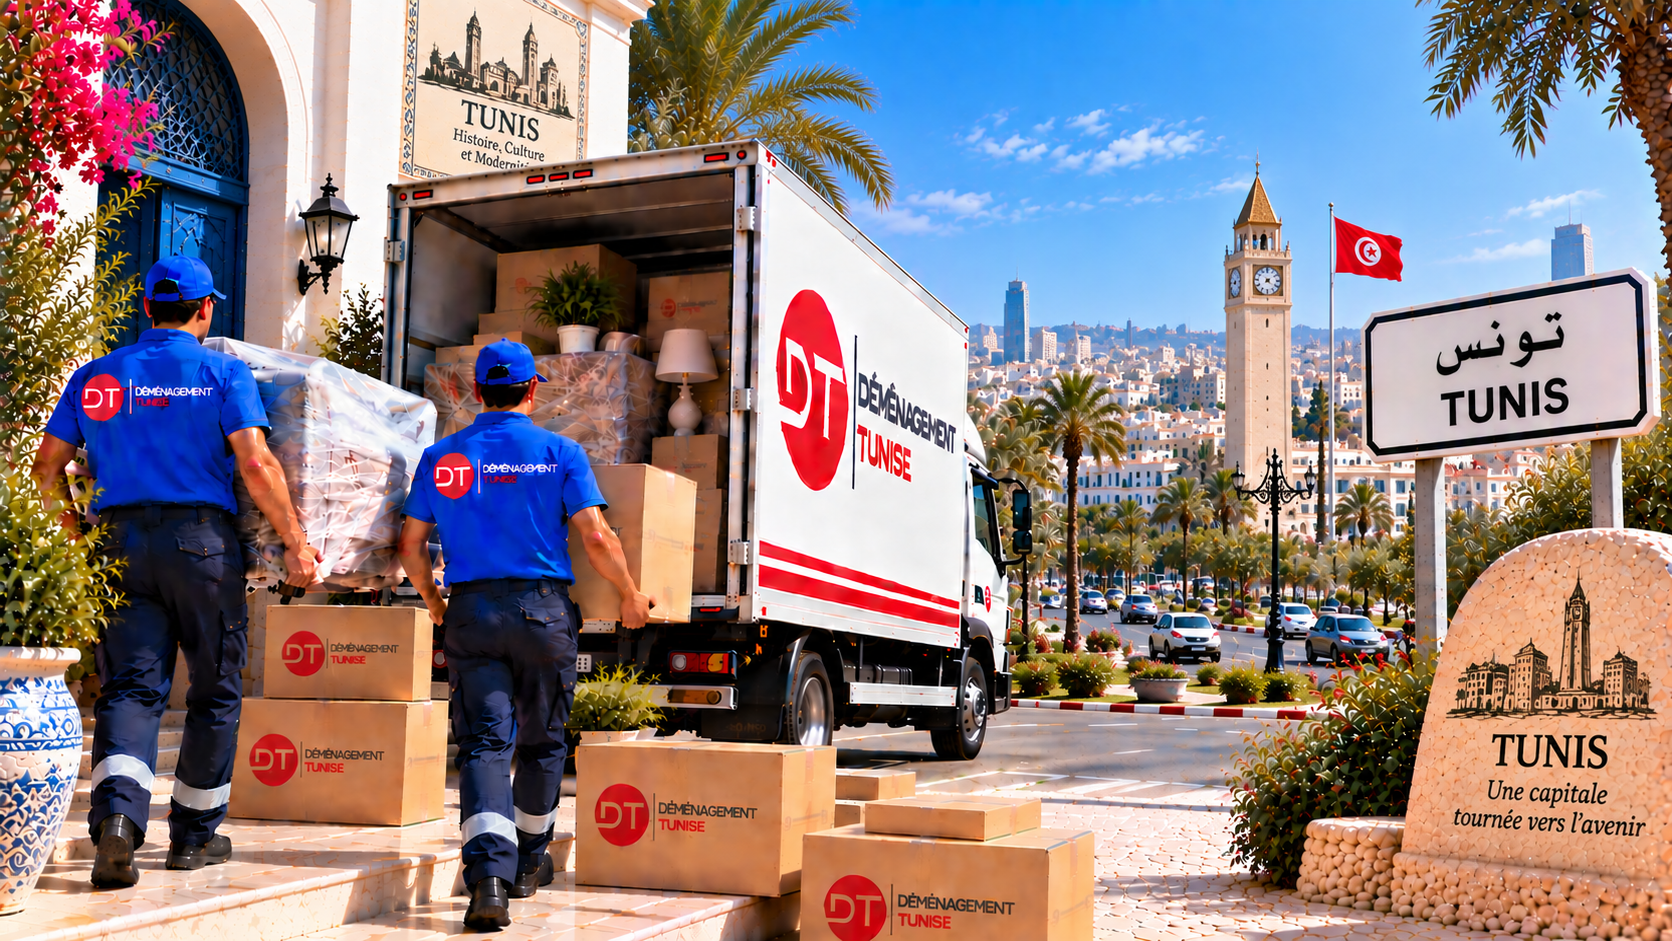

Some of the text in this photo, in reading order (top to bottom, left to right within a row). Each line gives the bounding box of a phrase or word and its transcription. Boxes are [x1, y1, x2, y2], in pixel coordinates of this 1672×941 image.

[461, 99, 540, 142] TUNIS
[453, 128, 545, 162] Histoire, Culture
[460, 149, 530, 170] et Moderni
[1436, 311, 1565, 376] تونس
[83, 388, 120, 409] DT
[779, 337, 847, 441] DT
[1440, 377, 1570, 427] TUNIS
[857, 371, 957, 454] DÉMÉNAGEMENT
[857, 424, 912, 483] TUNISE
[435, 466, 471, 487] DT
[282, 643, 322, 664] DT
[330, 655, 366, 665] TUNISE
[251, 748, 294, 771] DT
[304, 747, 385, 761] DÉMÉNAGEMENT
[1491, 733, 1608, 770] TUNIS
[304, 762, 344, 773] TUNISE
[1487, 779, 1608, 809] Une capitale
[595, 801, 644, 830] DT
[658, 800, 758, 820] DÉMÉNAGEMENT
[1453, 808, 1646, 837] tournée vers l'avenir
[658, 818, 706, 833] TUNISE
[825, 893, 882, 927] DT
[897, 892, 1015, 916] DÉMÉNAGEMENT
[897, 912, 952, 930] TUNISE
